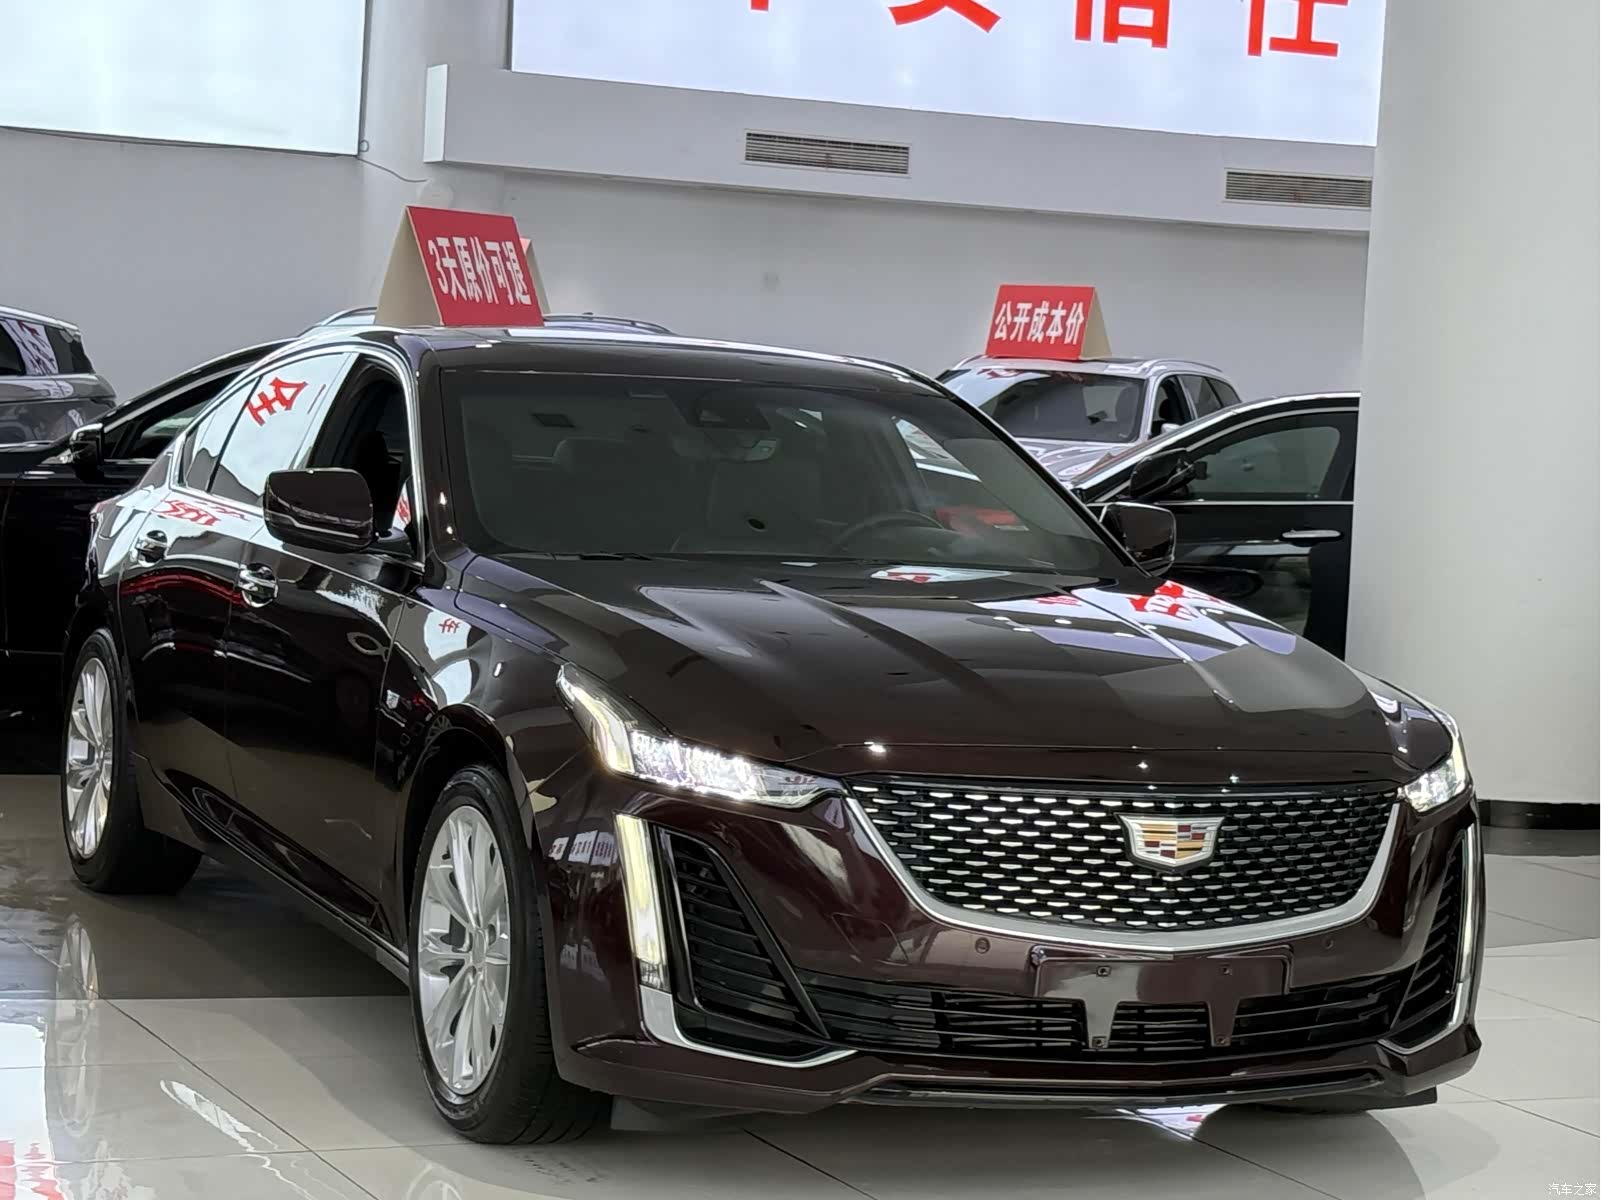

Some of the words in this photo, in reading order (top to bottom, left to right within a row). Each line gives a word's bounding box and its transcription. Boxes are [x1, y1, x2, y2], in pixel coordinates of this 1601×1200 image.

[427, 236, 532, 305] 3天原价可退
[994, 300, 1085, 345] 公开成本价
